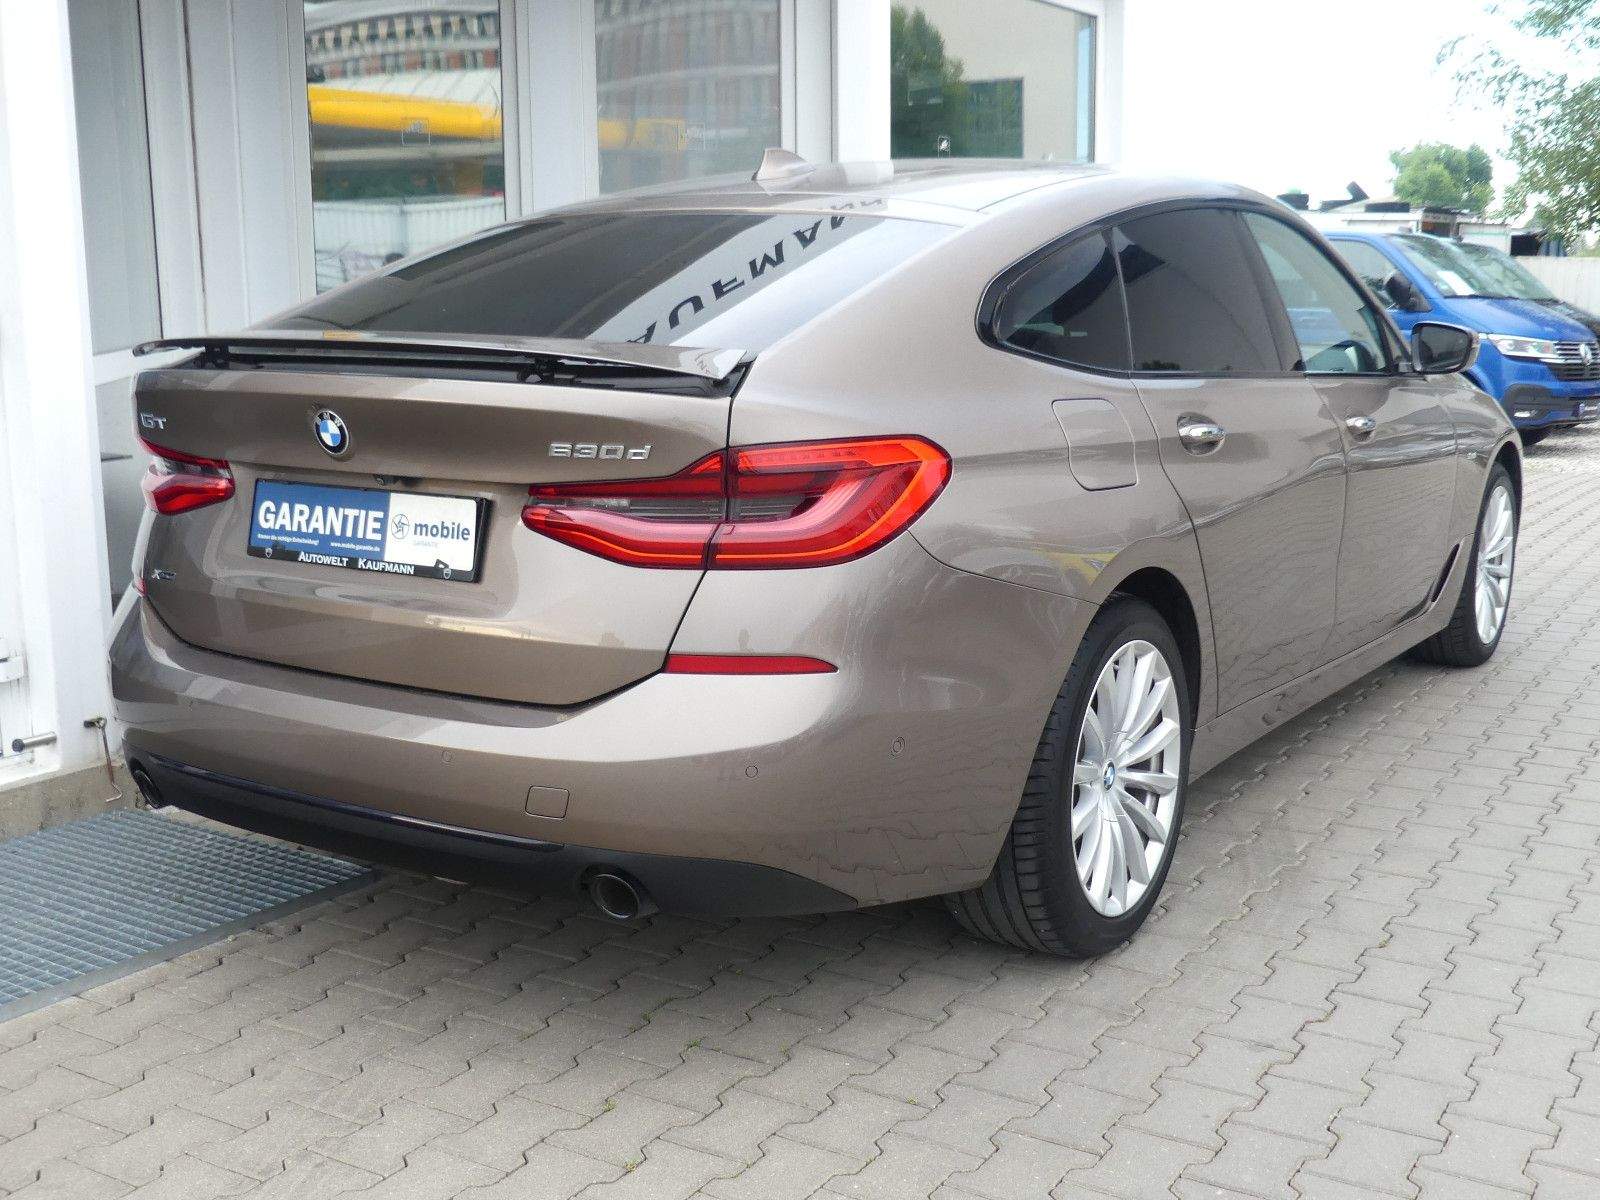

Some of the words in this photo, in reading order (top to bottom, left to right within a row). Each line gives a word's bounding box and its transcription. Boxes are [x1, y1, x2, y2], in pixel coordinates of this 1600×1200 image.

[548, 443, 652, 461] 630d
[258, 500, 385, 541] GARANTIE
[413, 520, 471, 541] mobile
